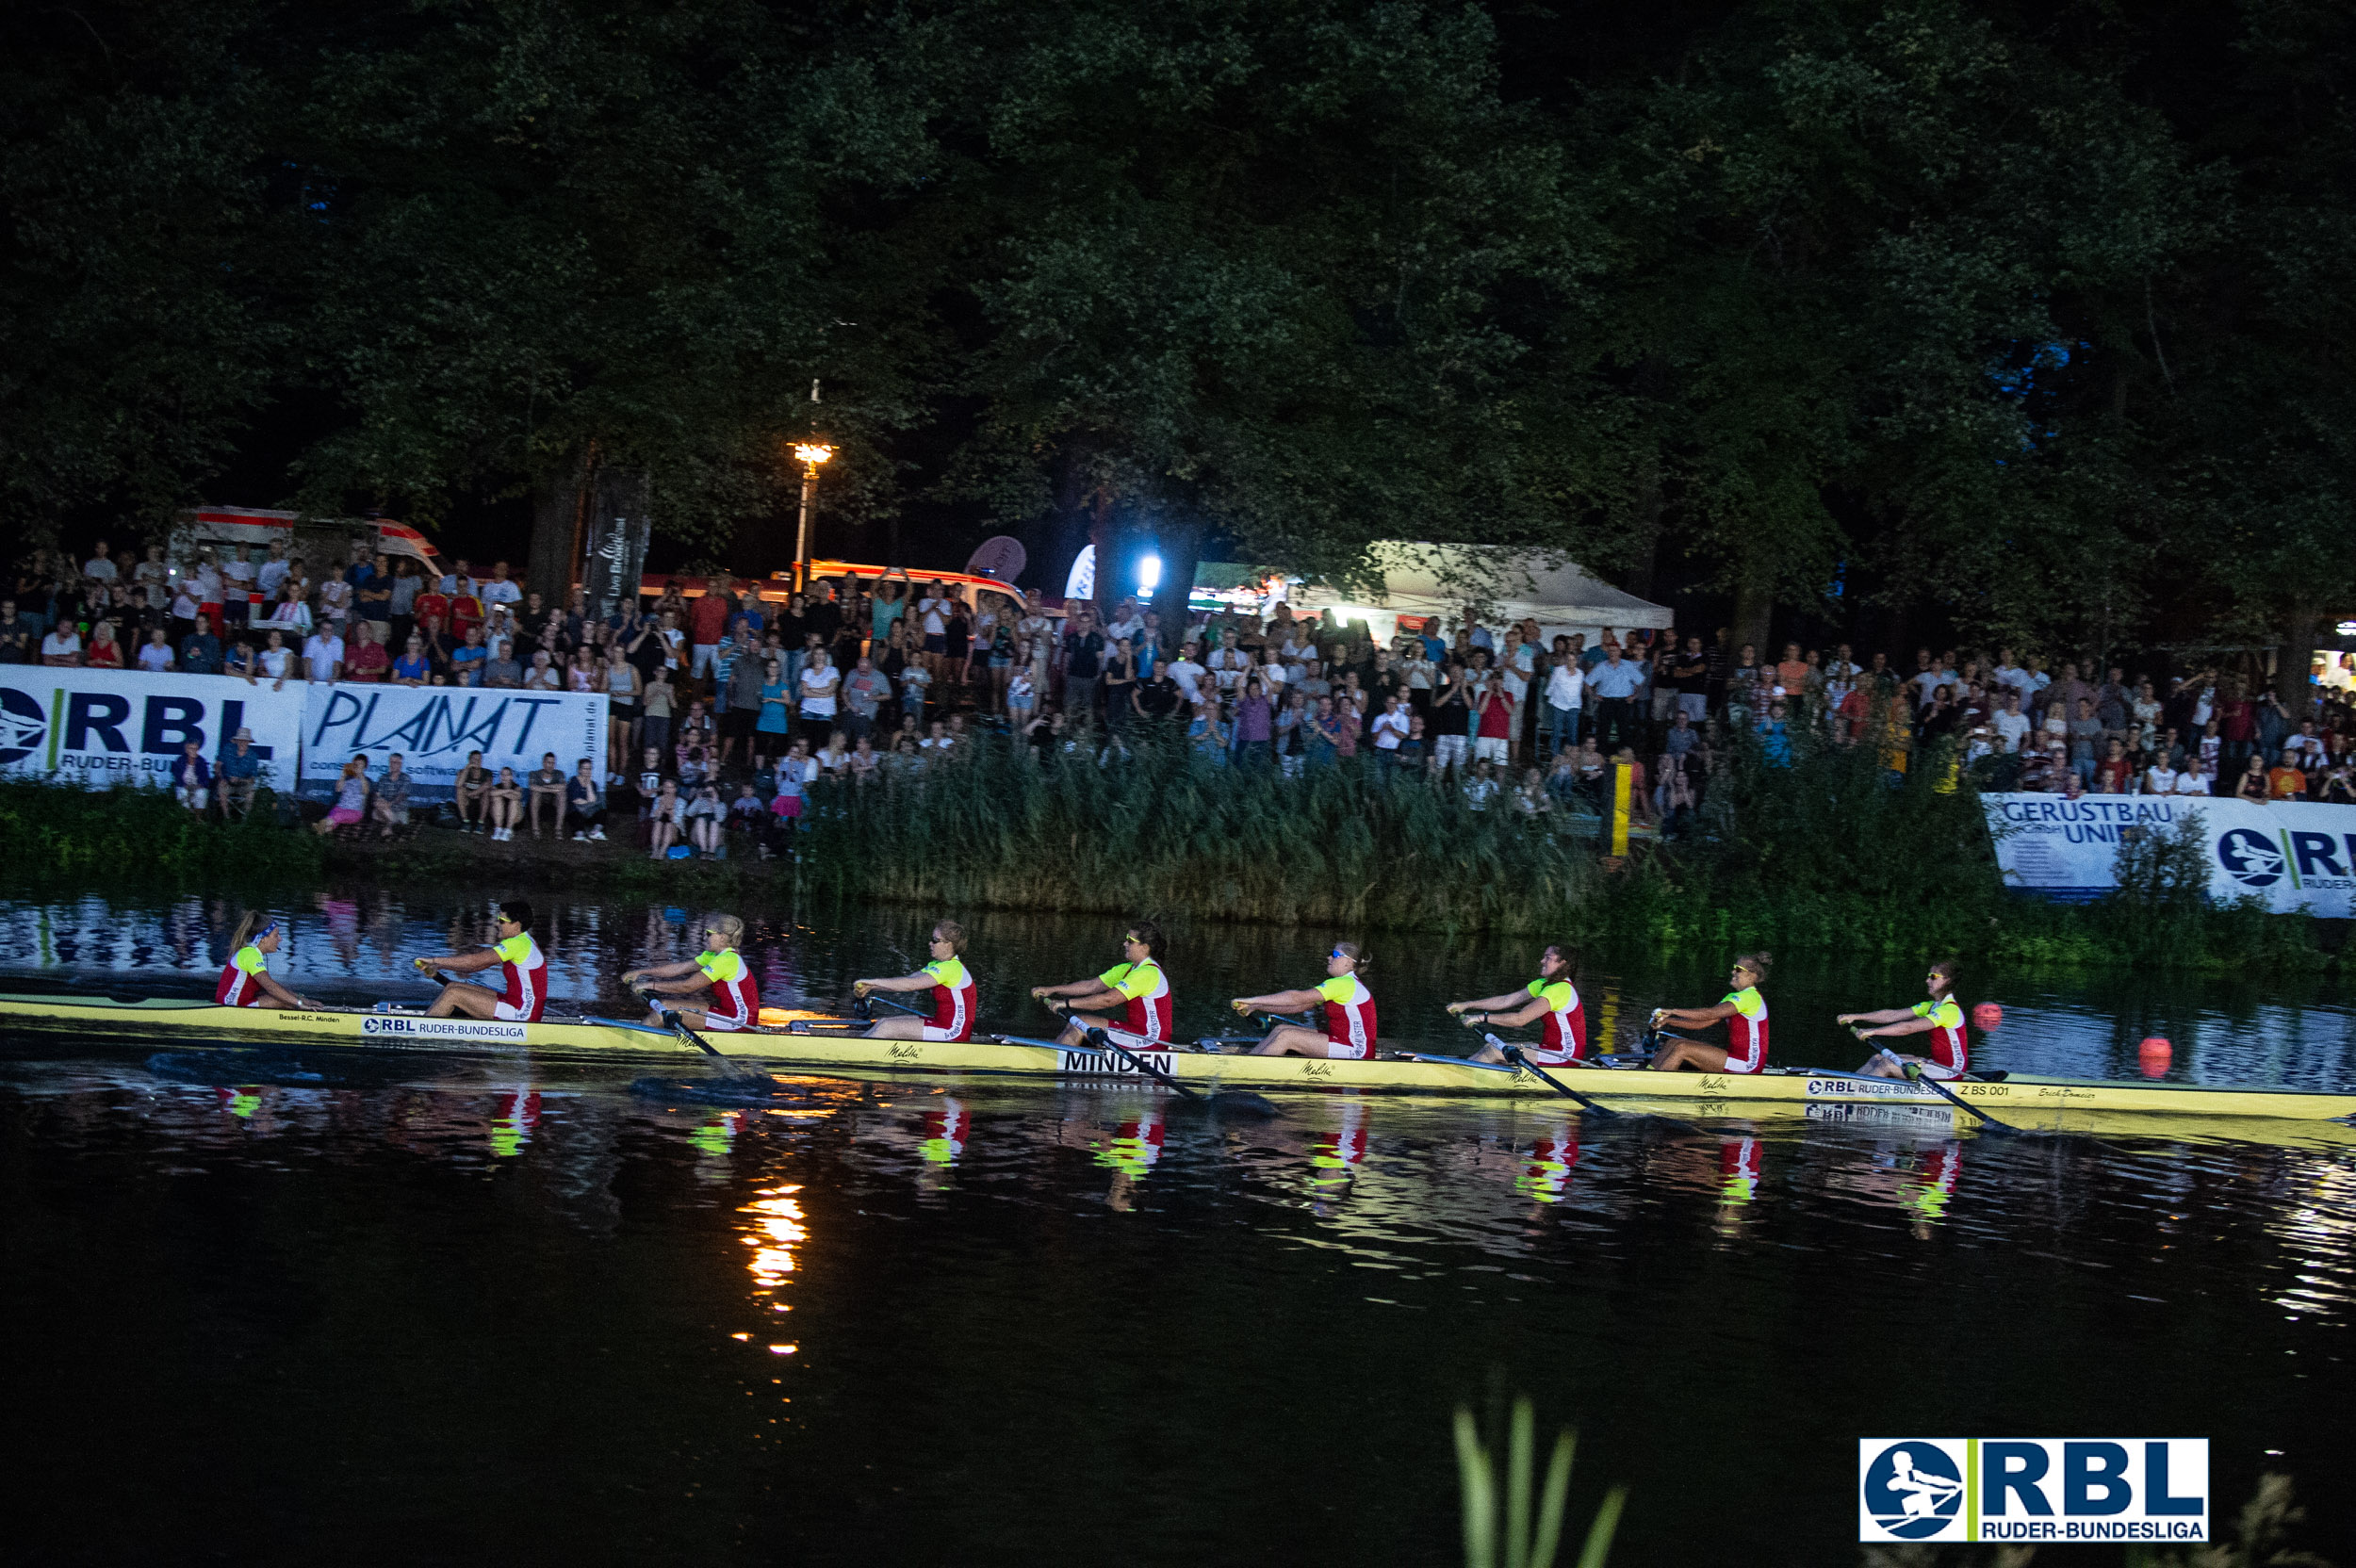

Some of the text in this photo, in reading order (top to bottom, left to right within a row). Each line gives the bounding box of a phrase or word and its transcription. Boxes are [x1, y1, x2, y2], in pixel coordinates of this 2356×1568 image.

[312, 690, 562, 758] PLANAT
[2290, 831, 2356, 876] R
[382, 1019, 524, 1037] RBL RUDER-BUNDESLIGA
[1065, 1051, 1171, 1074] MINDEN
[1824, 1081, 1855, 1093] RBL
[1960, 1086, 2010, 1097] Z BS 001
